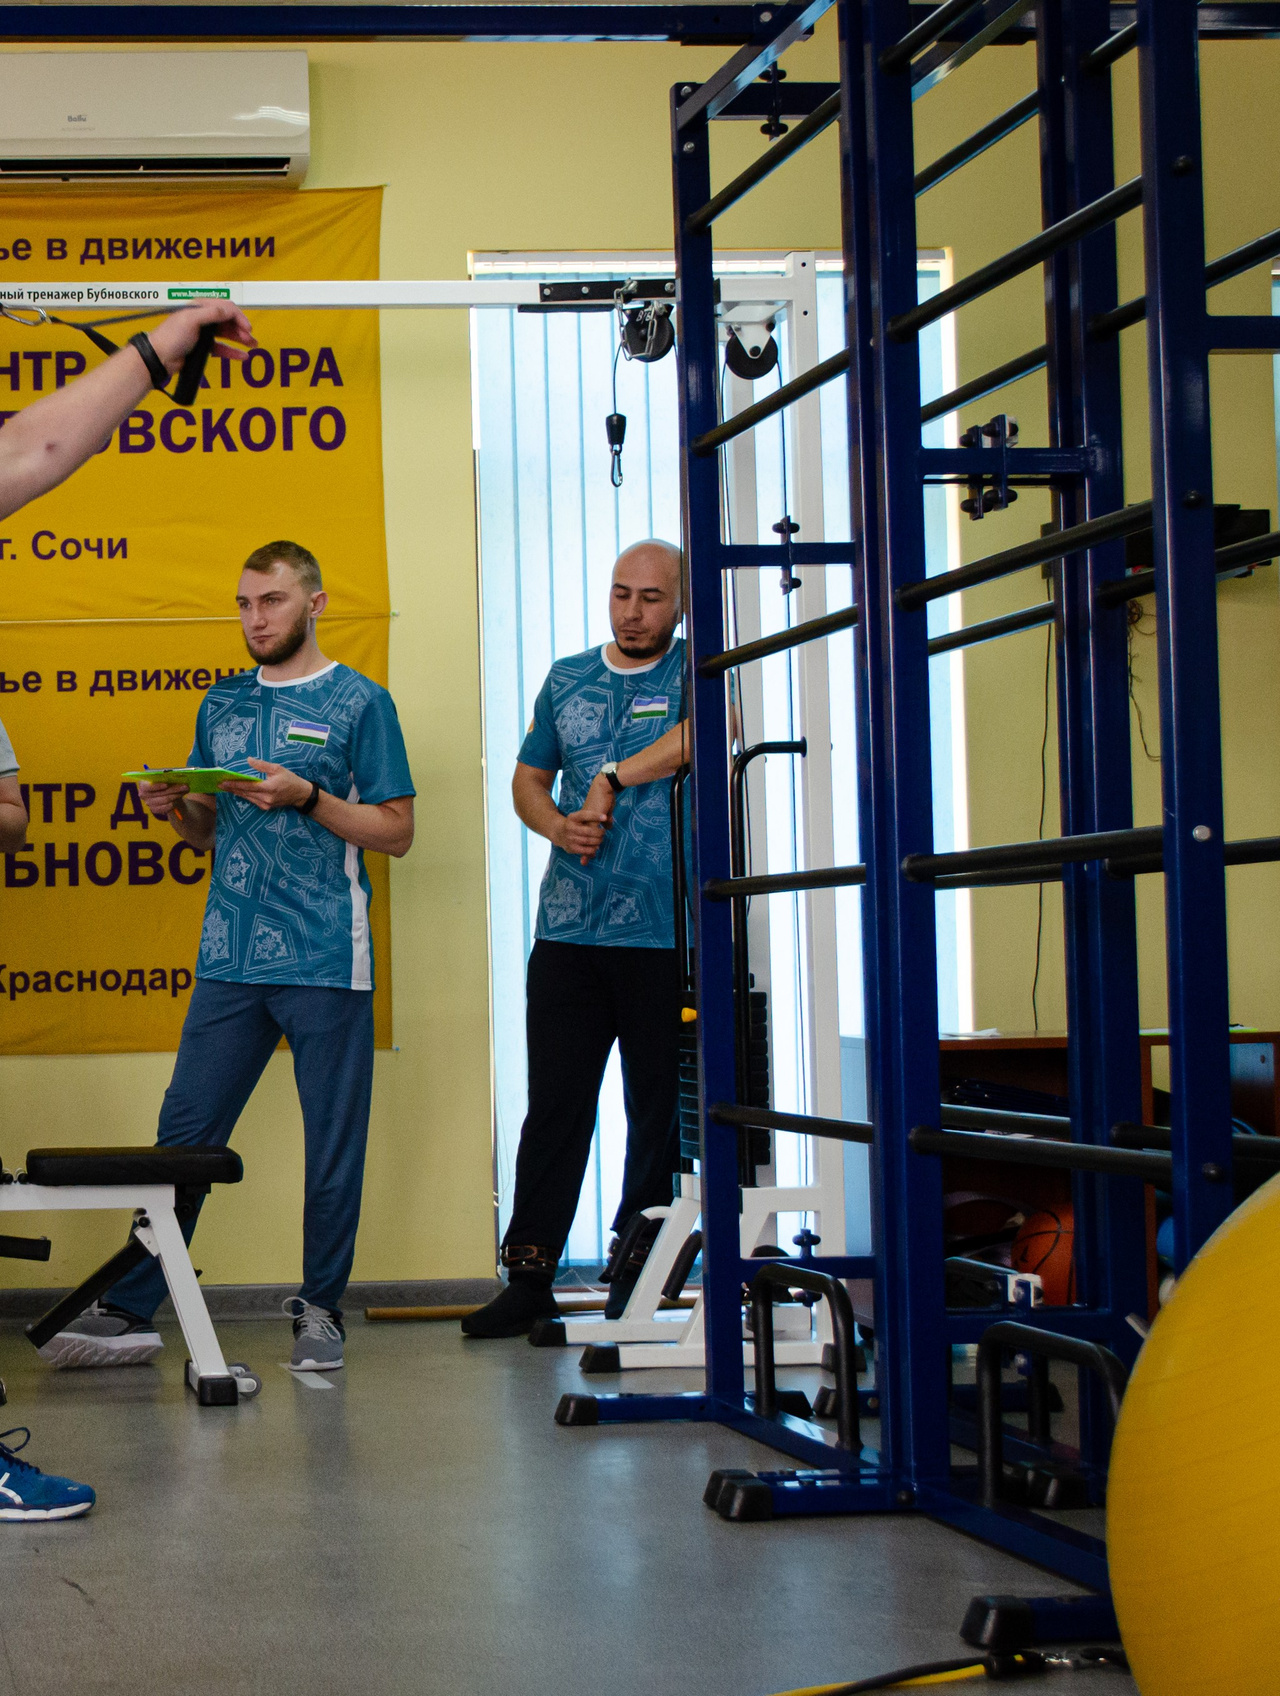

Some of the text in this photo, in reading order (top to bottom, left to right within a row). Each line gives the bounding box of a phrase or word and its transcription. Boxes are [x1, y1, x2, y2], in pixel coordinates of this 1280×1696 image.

[46, 237, 68, 260] в
[80, 236, 275, 265] движении
[27, 290, 83, 302] тренажер
[86, 288, 159, 302] Бубновского
[31, 530, 128, 560] Сочи
[57, 670, 78, 692] в
[89, 667, 245, 697] движен
